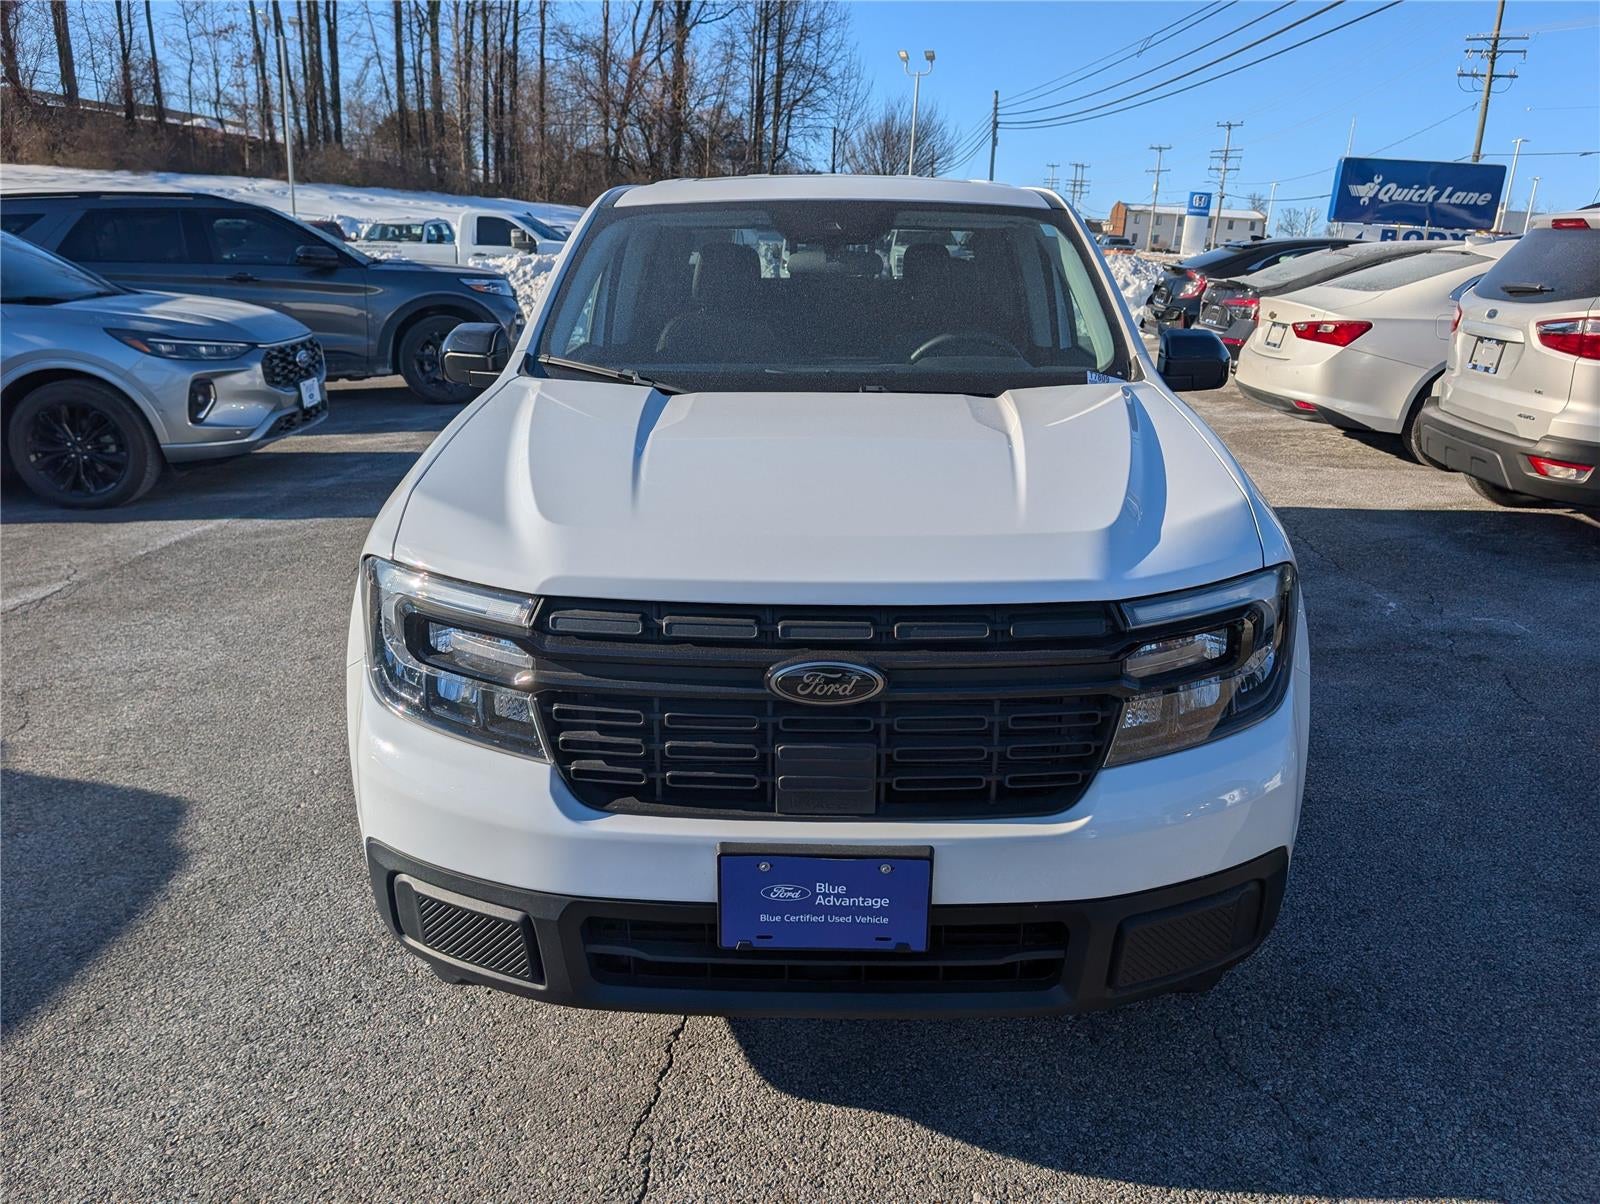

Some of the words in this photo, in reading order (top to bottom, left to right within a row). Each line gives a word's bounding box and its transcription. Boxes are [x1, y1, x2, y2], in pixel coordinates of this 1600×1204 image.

[1377, 182, 1440, 203] Quick
[1438, 186, 1493, 206] Lane
[1380, 229, 1471, 242] BODY
[796, 671, 861, 696] Ford
[769, 886, 802, 900] Ford
[816, 882, 847, 894] Blue
[815, 894, 890, 909] Advantage
[760, 913, 781, 923] Blue
[784, 913, 825, 923] Certified
[827, 914, 852, 923] Used
[855, 915, 889, 924] Vehicle
